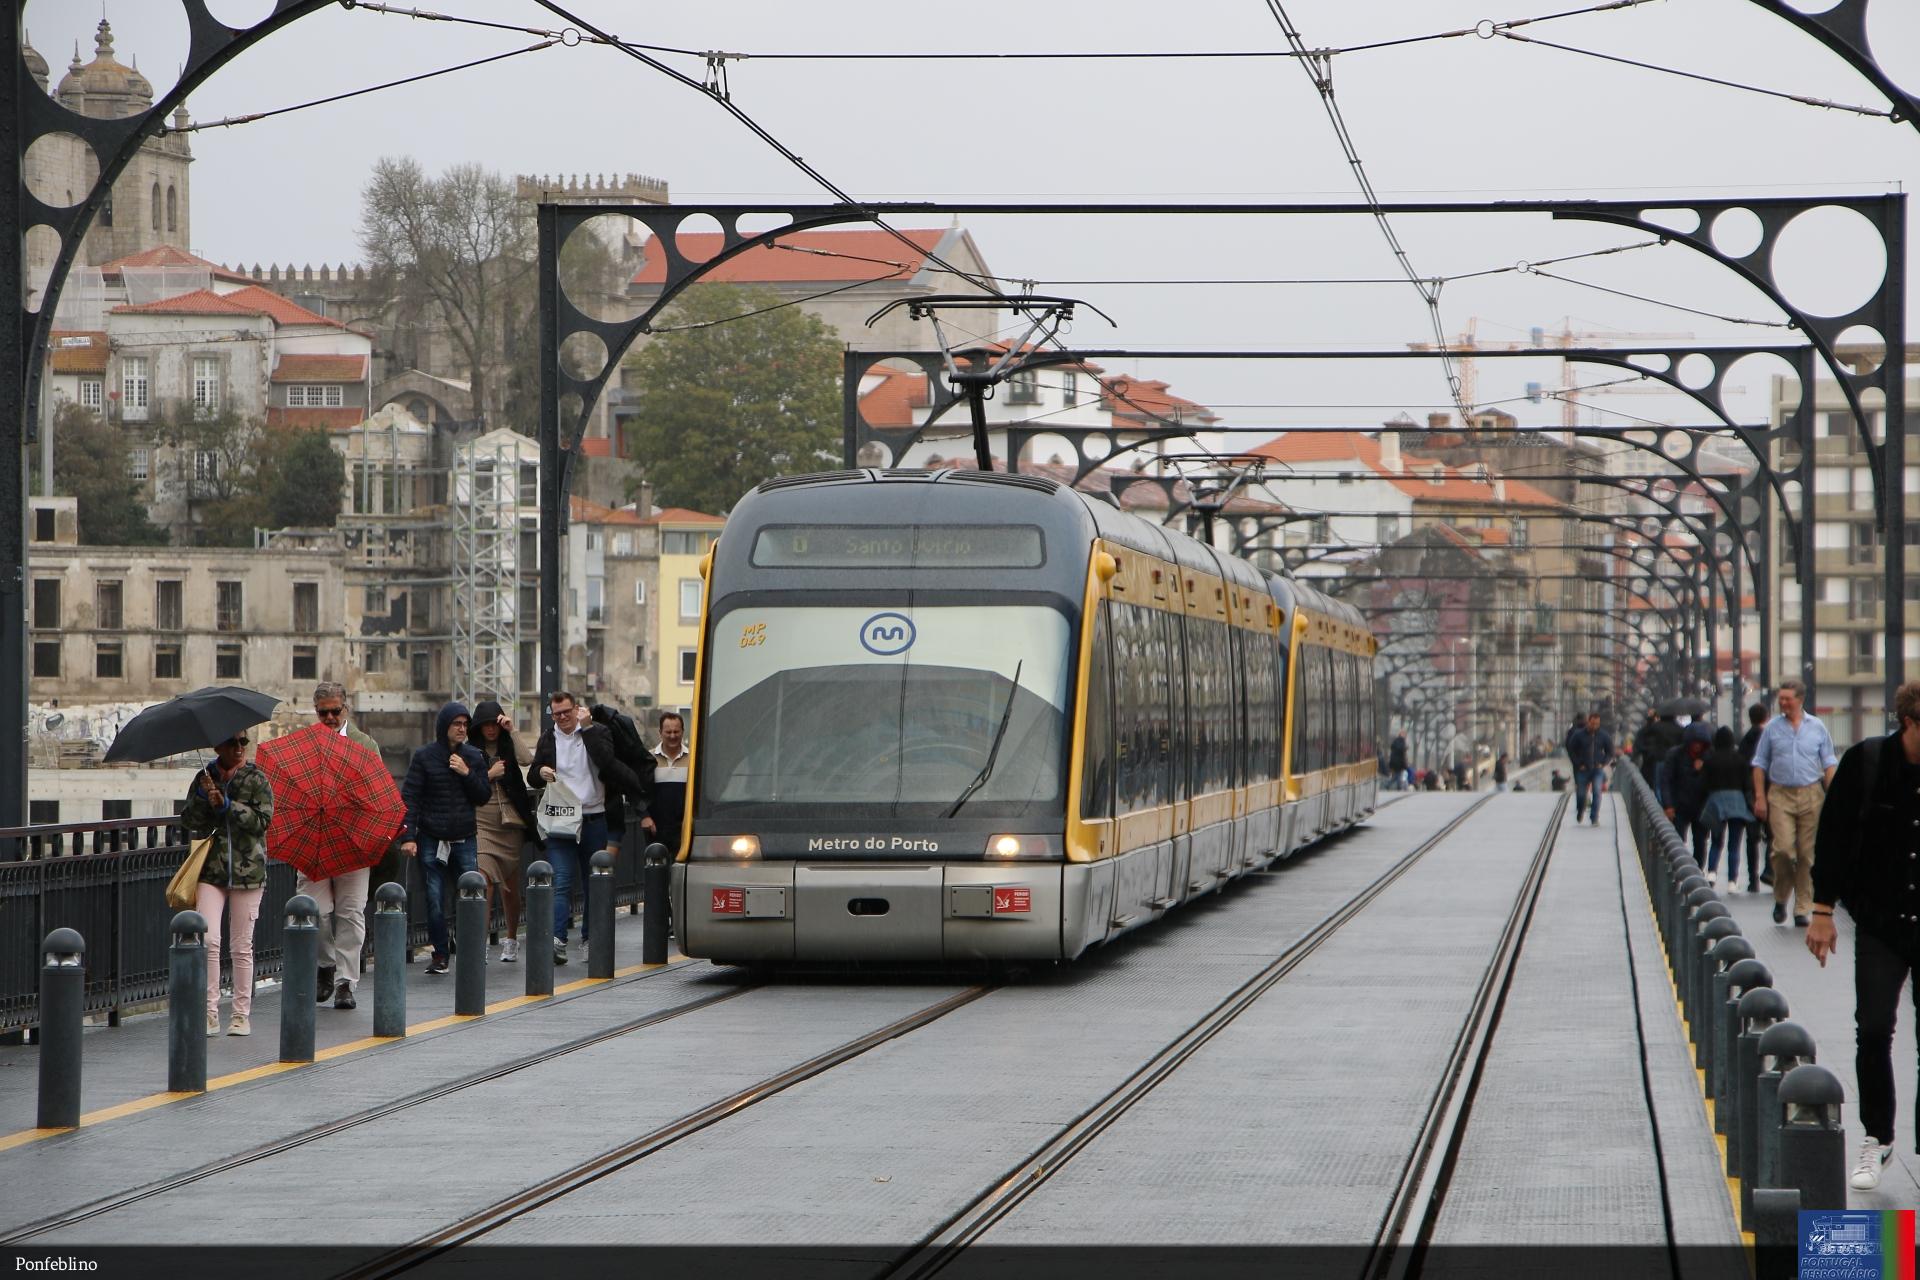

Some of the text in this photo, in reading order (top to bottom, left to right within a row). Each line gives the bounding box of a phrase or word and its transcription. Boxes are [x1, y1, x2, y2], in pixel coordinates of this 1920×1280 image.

[808, 836, 939, 852] Metro do Porto
